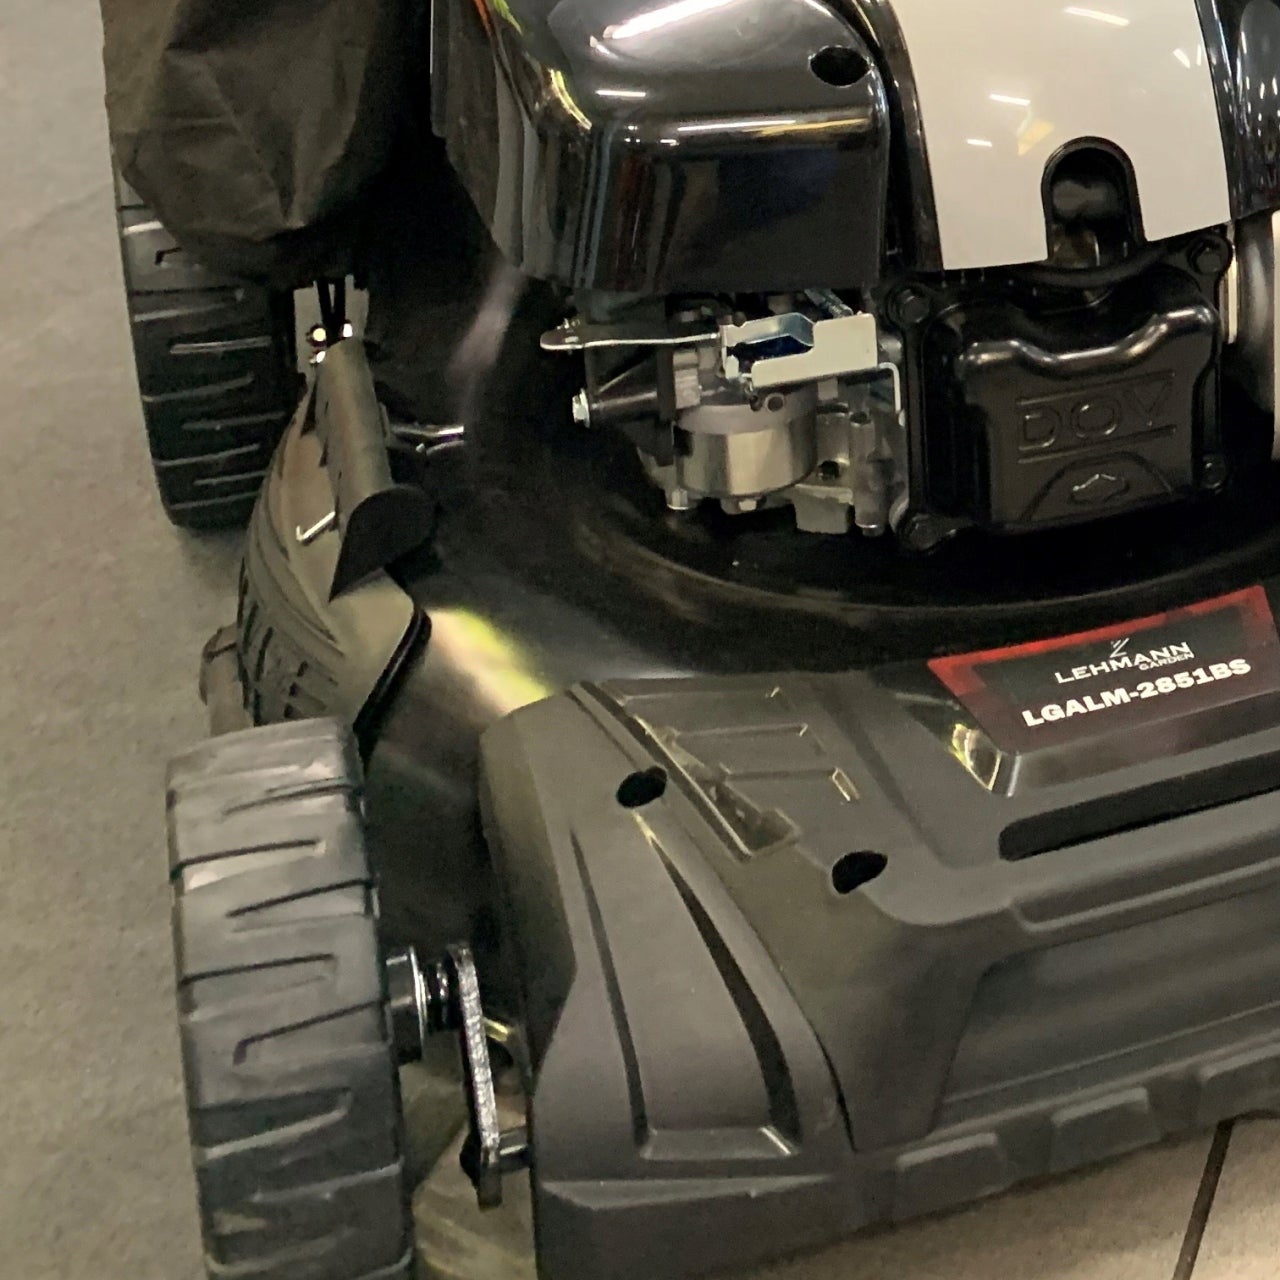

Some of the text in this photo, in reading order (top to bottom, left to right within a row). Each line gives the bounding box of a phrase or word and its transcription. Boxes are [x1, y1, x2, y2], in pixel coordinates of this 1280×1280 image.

[1054, 642, 1192, 684] LEHMANN
[1138, 652, 1195, 671] GARDEN
[1021, 658, 1252, 727] LGALM-2851BS
